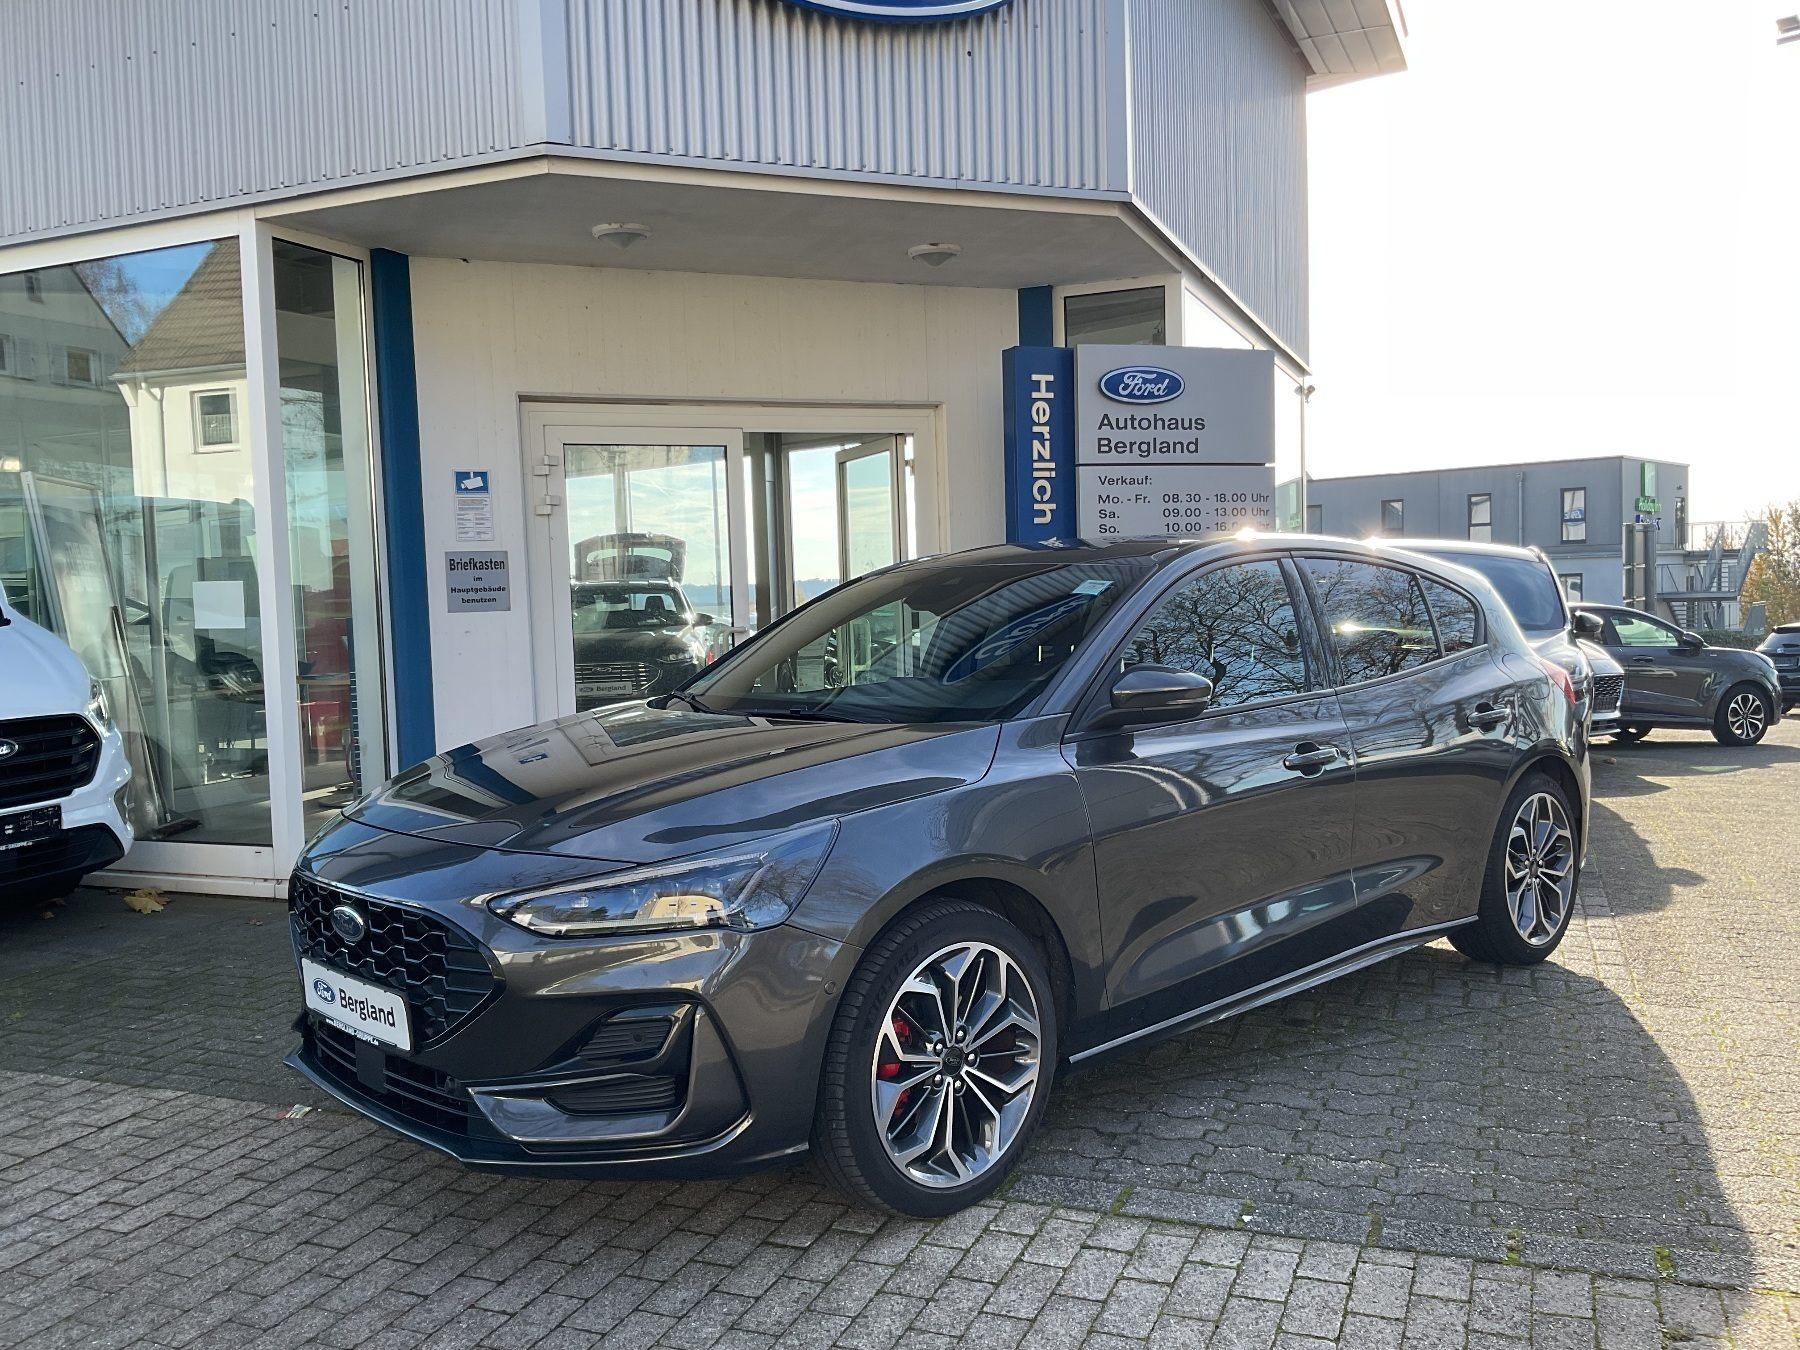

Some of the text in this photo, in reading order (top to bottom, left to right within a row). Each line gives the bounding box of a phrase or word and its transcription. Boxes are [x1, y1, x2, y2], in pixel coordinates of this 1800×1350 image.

[1119, 372, 1169, 396] Ford
[1097, 413, 1206, 431] Autohaus
[1031, 374, 1057, 524] Herzlich
[1097, 437, 1199, 458] Bergland
[1098, 475, 1152, 486] Verkauf:
[1098, 494, 1124, 504] Mo.
[1135, 494, 1151, 504] Fr.
[1162, 493, 1201, 504] 08.30
[1214, 493, 1247, 503] 18.00
[1251, 493, 1269, 503] Uhr
[1098, 508, 1120, 519] Sa.
[1162, 508, 1202, 518] 09.00
[1214, 507, 1247, 517] 13.00
[1251, 507, 1270, 517] Uhr
[1098, 523, 1120, 534] So.
[1164, 522, 1202, 533] 10.00
[449, 557, 505, 571] Briefkasten
[450, 586, 507, 595] Hauptgebäude
[339, 987, 396, 1028] Bergland
